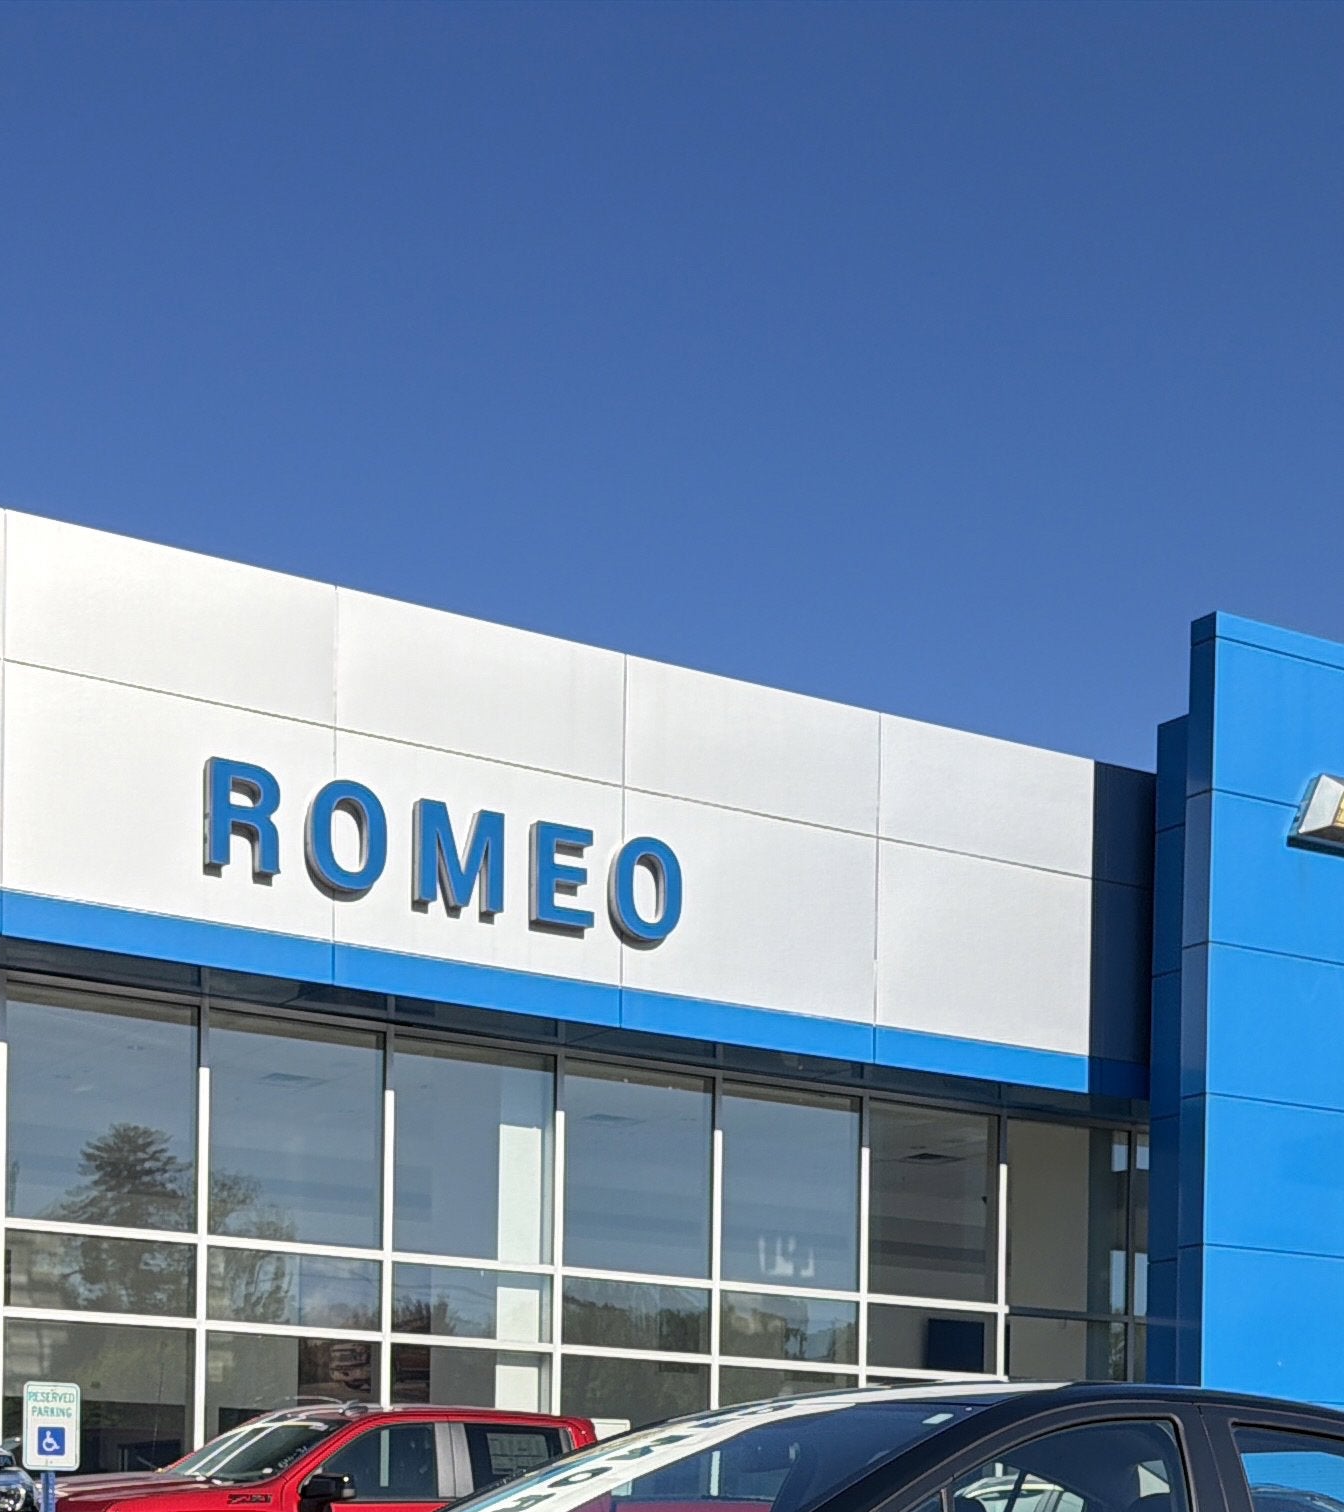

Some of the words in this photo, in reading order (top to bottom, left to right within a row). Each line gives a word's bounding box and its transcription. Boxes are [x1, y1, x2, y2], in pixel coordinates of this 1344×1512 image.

[203, 756, 683, 947] ROMEO
[28, 1391, 75, 1404] RESERVED
[31, 1405, 73, 1418] PARKING
